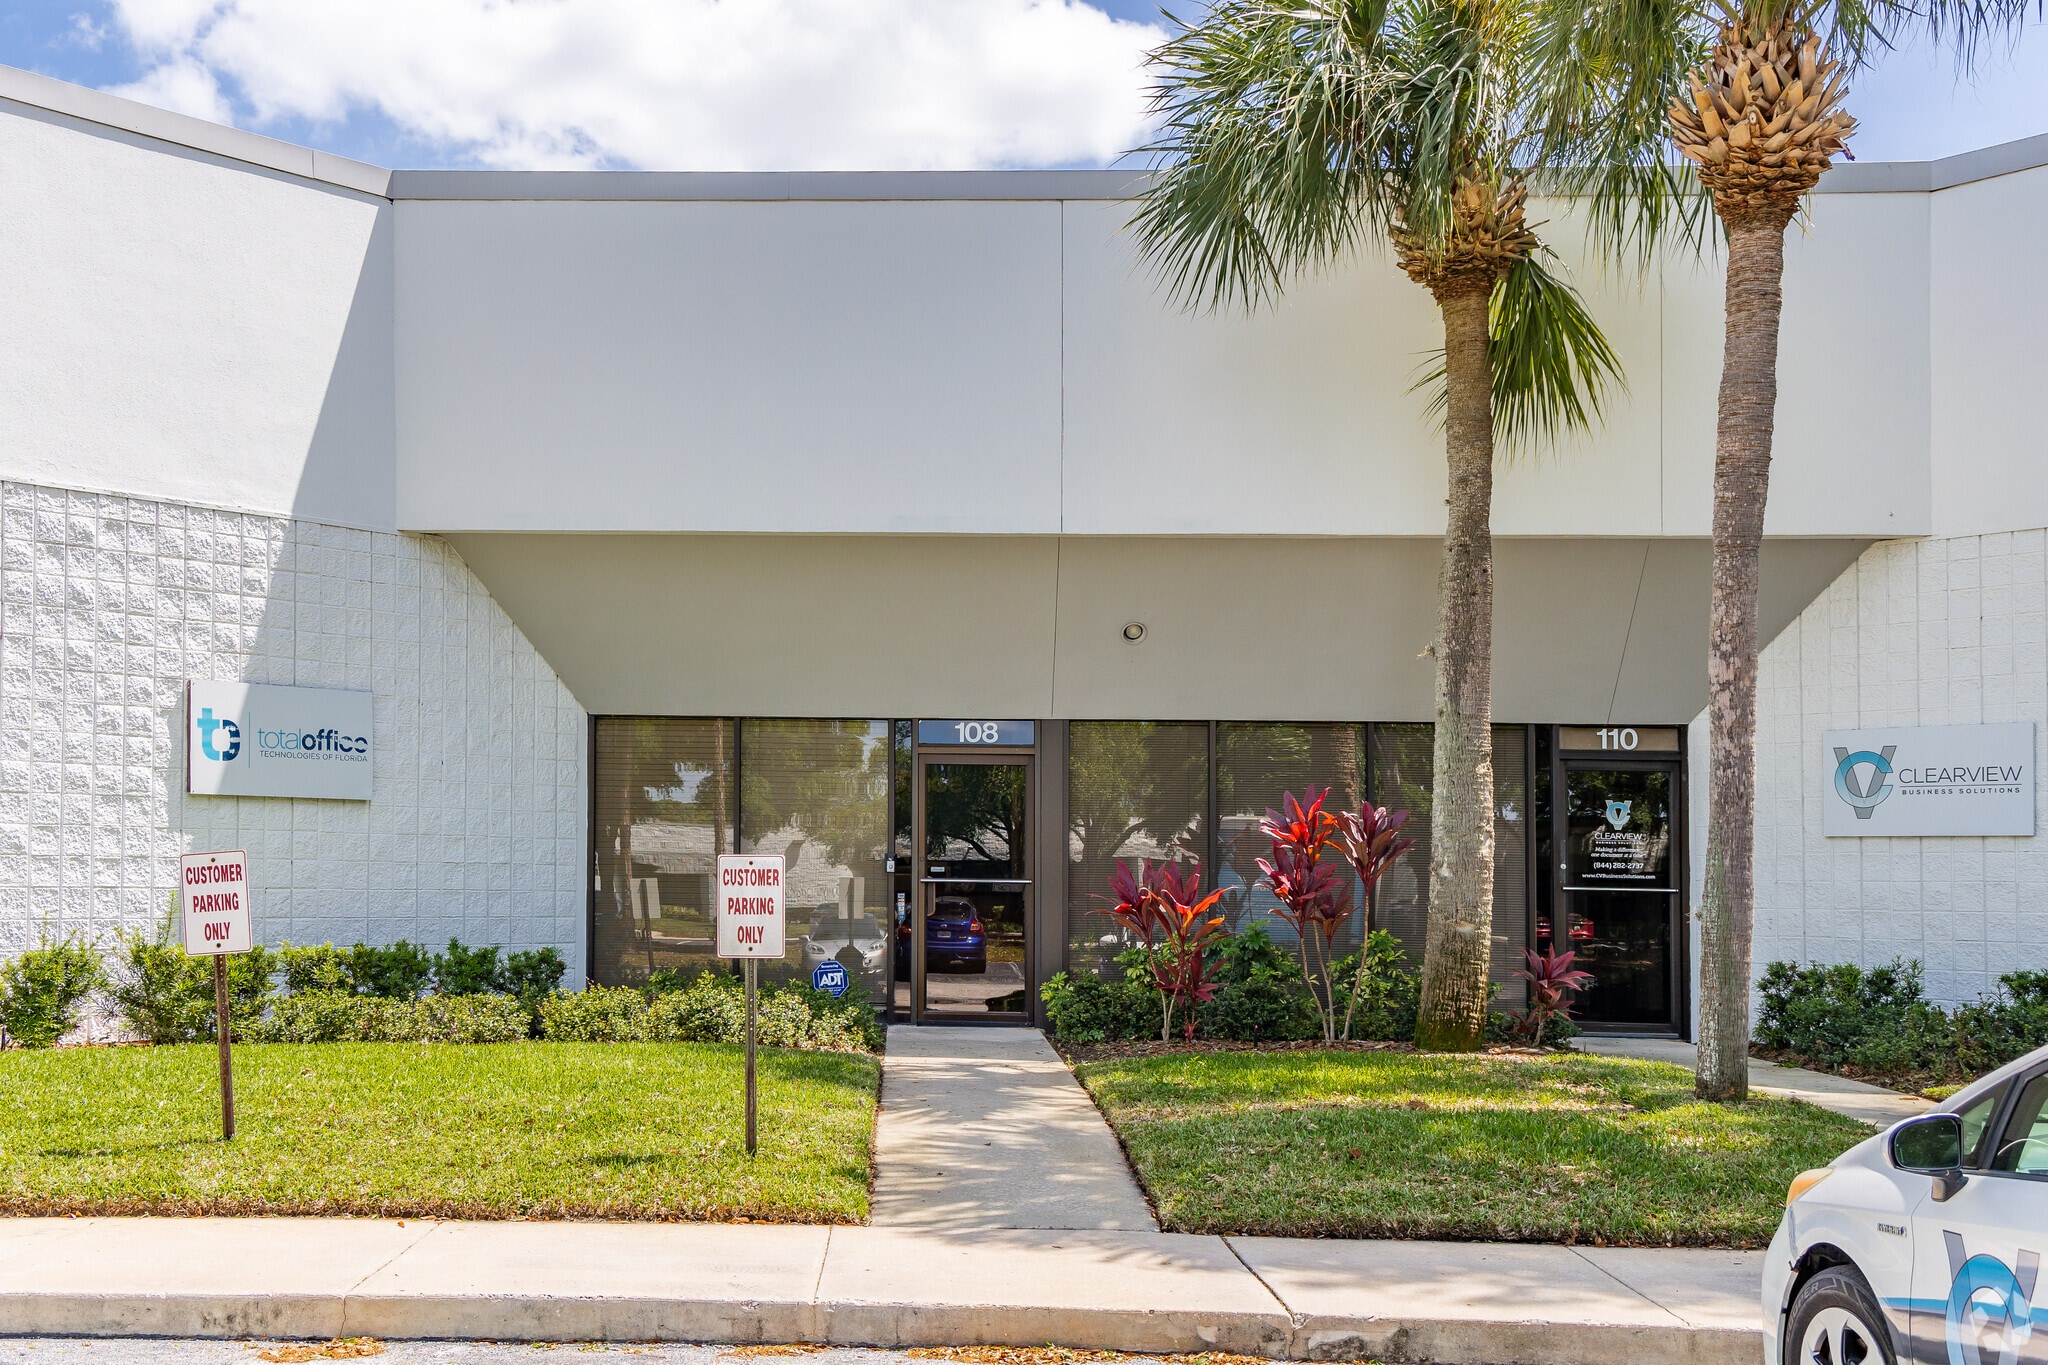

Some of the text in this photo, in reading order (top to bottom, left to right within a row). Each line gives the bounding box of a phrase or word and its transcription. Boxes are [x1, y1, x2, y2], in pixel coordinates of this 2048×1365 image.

[955, 722, 999, 743] 108
[1597, 728, 1639, 750] 110
[260, 750, 368, 763] TECHNOLOGIES OF FLORIDA
[1899, 766, 2022, 784] CLEARVIEW
[1901, 787, 2021, 796] BUSINESS SOLUTIONS
[1594, 832, 1643, 840] CLEARVIEW
[186, 863, 243, 885] CUSTOMER
[1593, 862, 1612, 870] (844)
[722, 868, 779, 887] CUSTOMER
[192, 892, 239, 913] PARKING
[727, 897, 774, 915] PARKING
[204, 921, 231, 941] ONLY
[737, 926, 764, 944] ONLY
[820, 972, 843, 986] ADT
